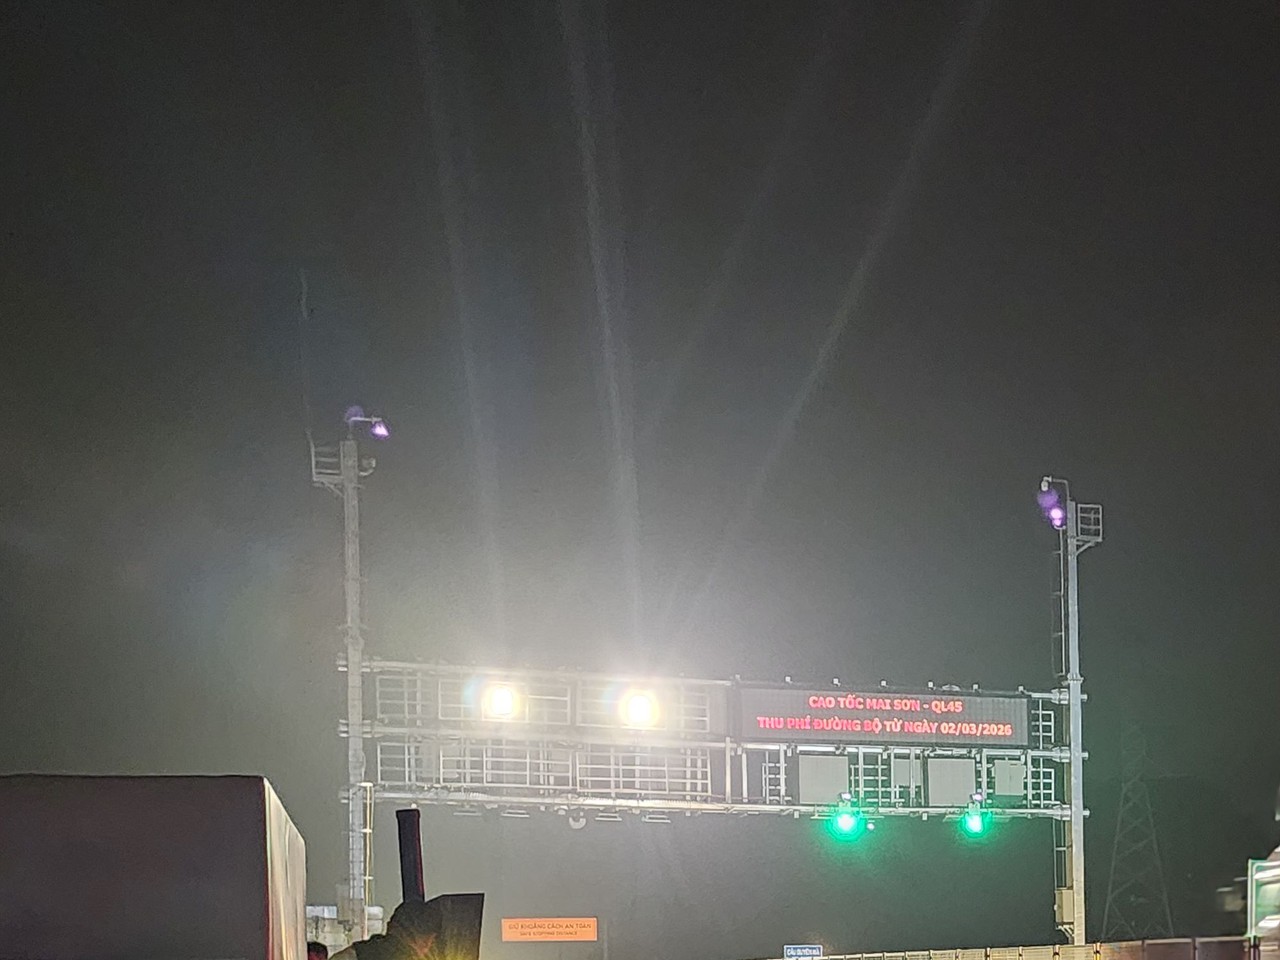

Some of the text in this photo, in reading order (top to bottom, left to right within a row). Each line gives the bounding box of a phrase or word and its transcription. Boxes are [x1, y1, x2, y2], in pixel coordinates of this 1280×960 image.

[808, 696, 836, 709] CAO
[838, 694, 864, 710] TỐC
[866, 698, 892, 711] MAI
[893, 698, 921, 712] SƠN
[931, 700, 963, 714] QL45
[756, 714, 1013, 736] THU PHÍ ĐƯỜNG BỘ TỪ NGÀY 02/03/2026
